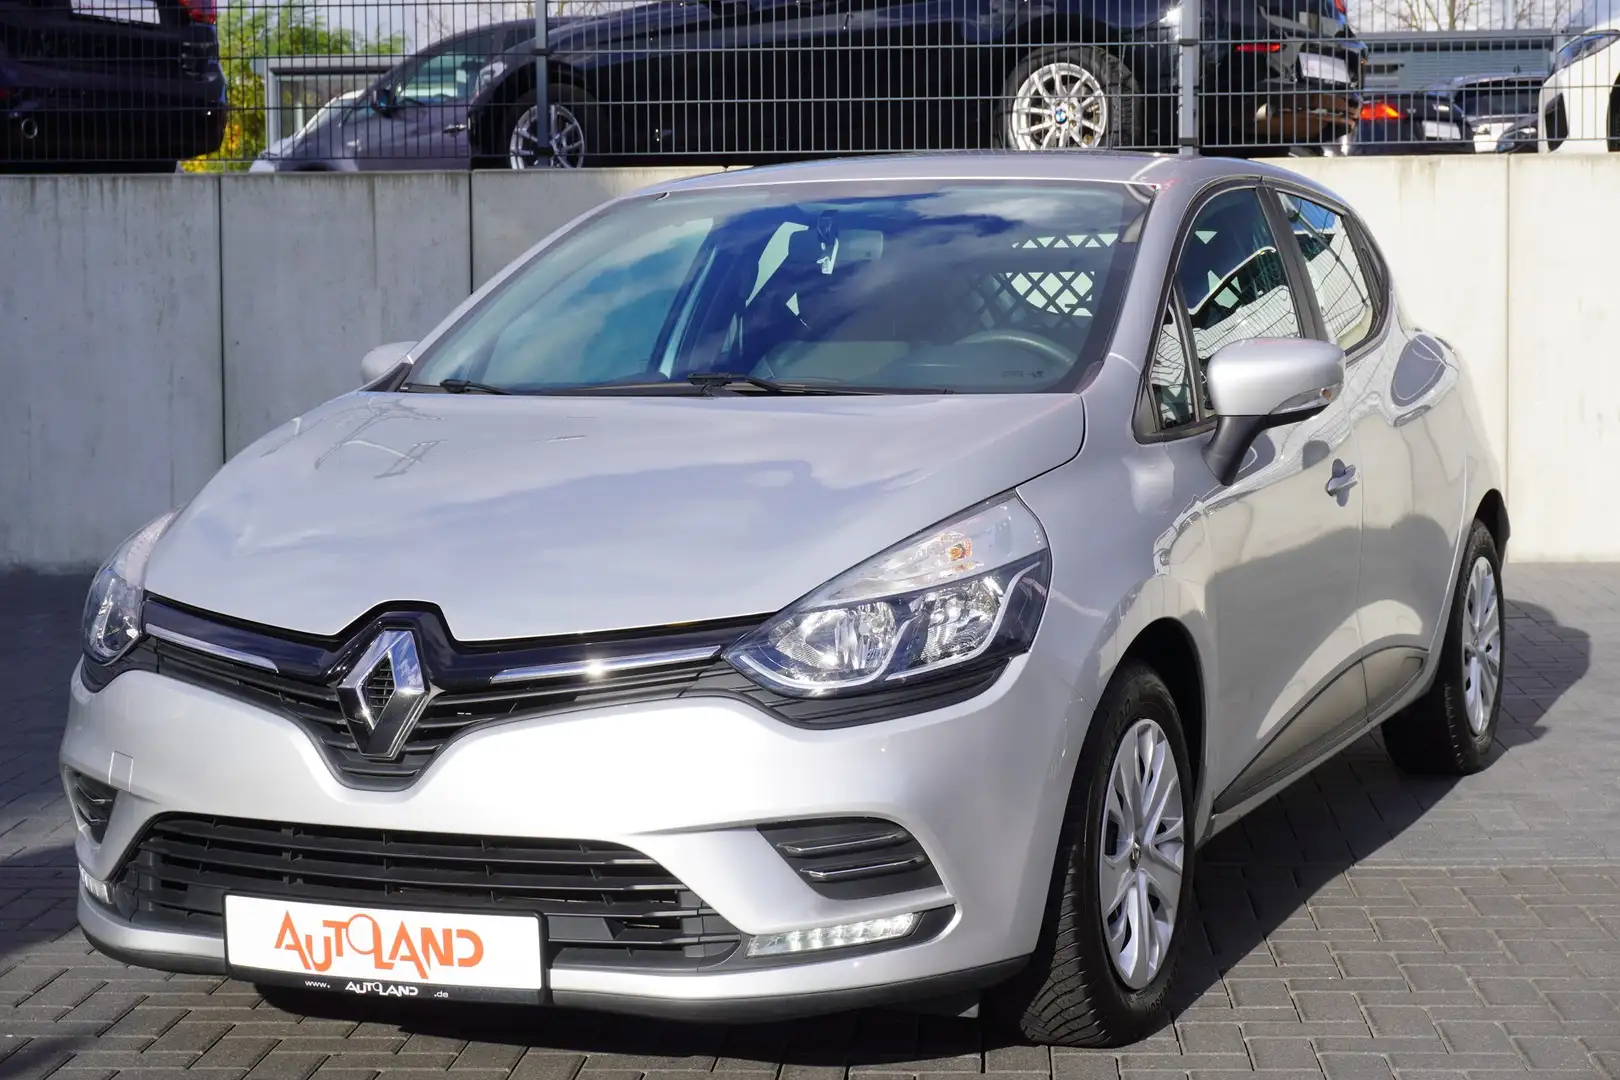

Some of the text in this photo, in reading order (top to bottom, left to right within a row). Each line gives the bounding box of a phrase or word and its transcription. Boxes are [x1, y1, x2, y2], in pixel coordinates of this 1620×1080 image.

[275, 911, 484, 979] AUTOLAND
[304, 979, 449, 999] www. AUTOLAND .de
